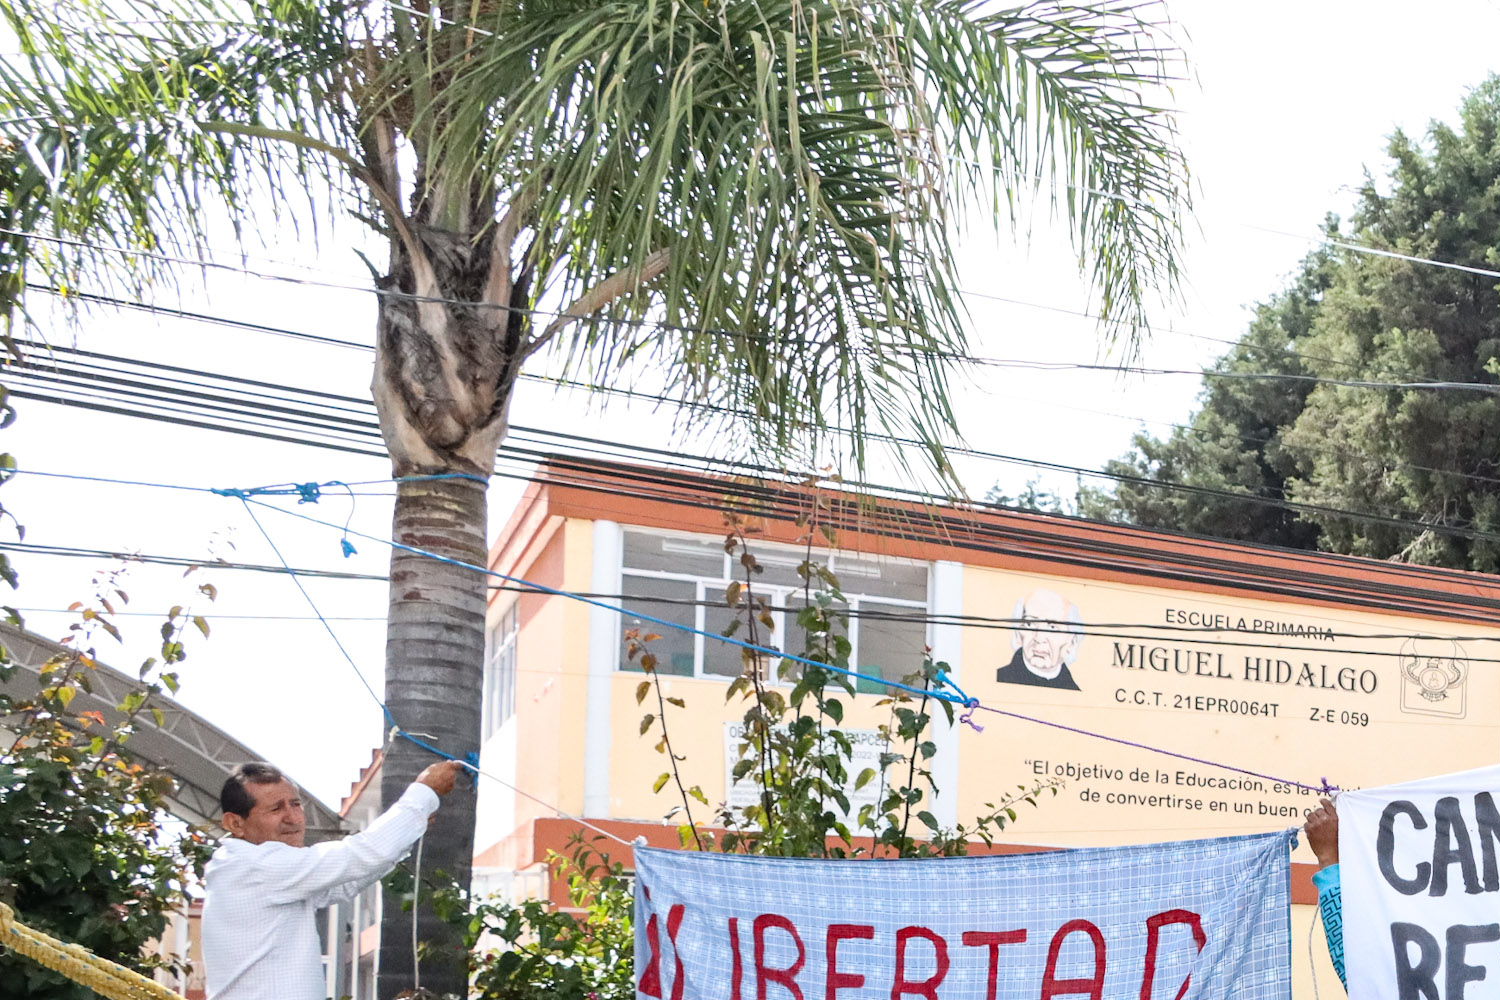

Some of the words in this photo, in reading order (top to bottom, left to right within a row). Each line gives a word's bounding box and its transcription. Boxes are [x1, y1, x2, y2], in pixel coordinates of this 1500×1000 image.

[1165, 608, 1248, 631] ESCUELA
[1252, 618, 1336, 642] PRIMARIA
[1111, 641, 1233, 680] MIGUEL
[1242, 655, 1378, 694] HIDALGO
[1114, 688, 1168, 707] C.C.T.
[1173, 694, 1280, 718] 21EPR0064T
[1340, 710, 1370, 727] 059
[1054, 762, 1124, 781] objetivo
[1129, 768, 1150, 783] de
[1155, 769, 1170, 784] la
[1175, 771, 1268, 793] Educación,
[1272, 782, 1292, 795] es
[1296, 781, 1310, 796] la
[1079, 788, 1101, 803] de
[1106, 791, 1203, 810] convertirse
[1209, 800, 1228, 813] en
[1233, 801, 1253, 814] un
[1258, 801, 1299, 817] buen
